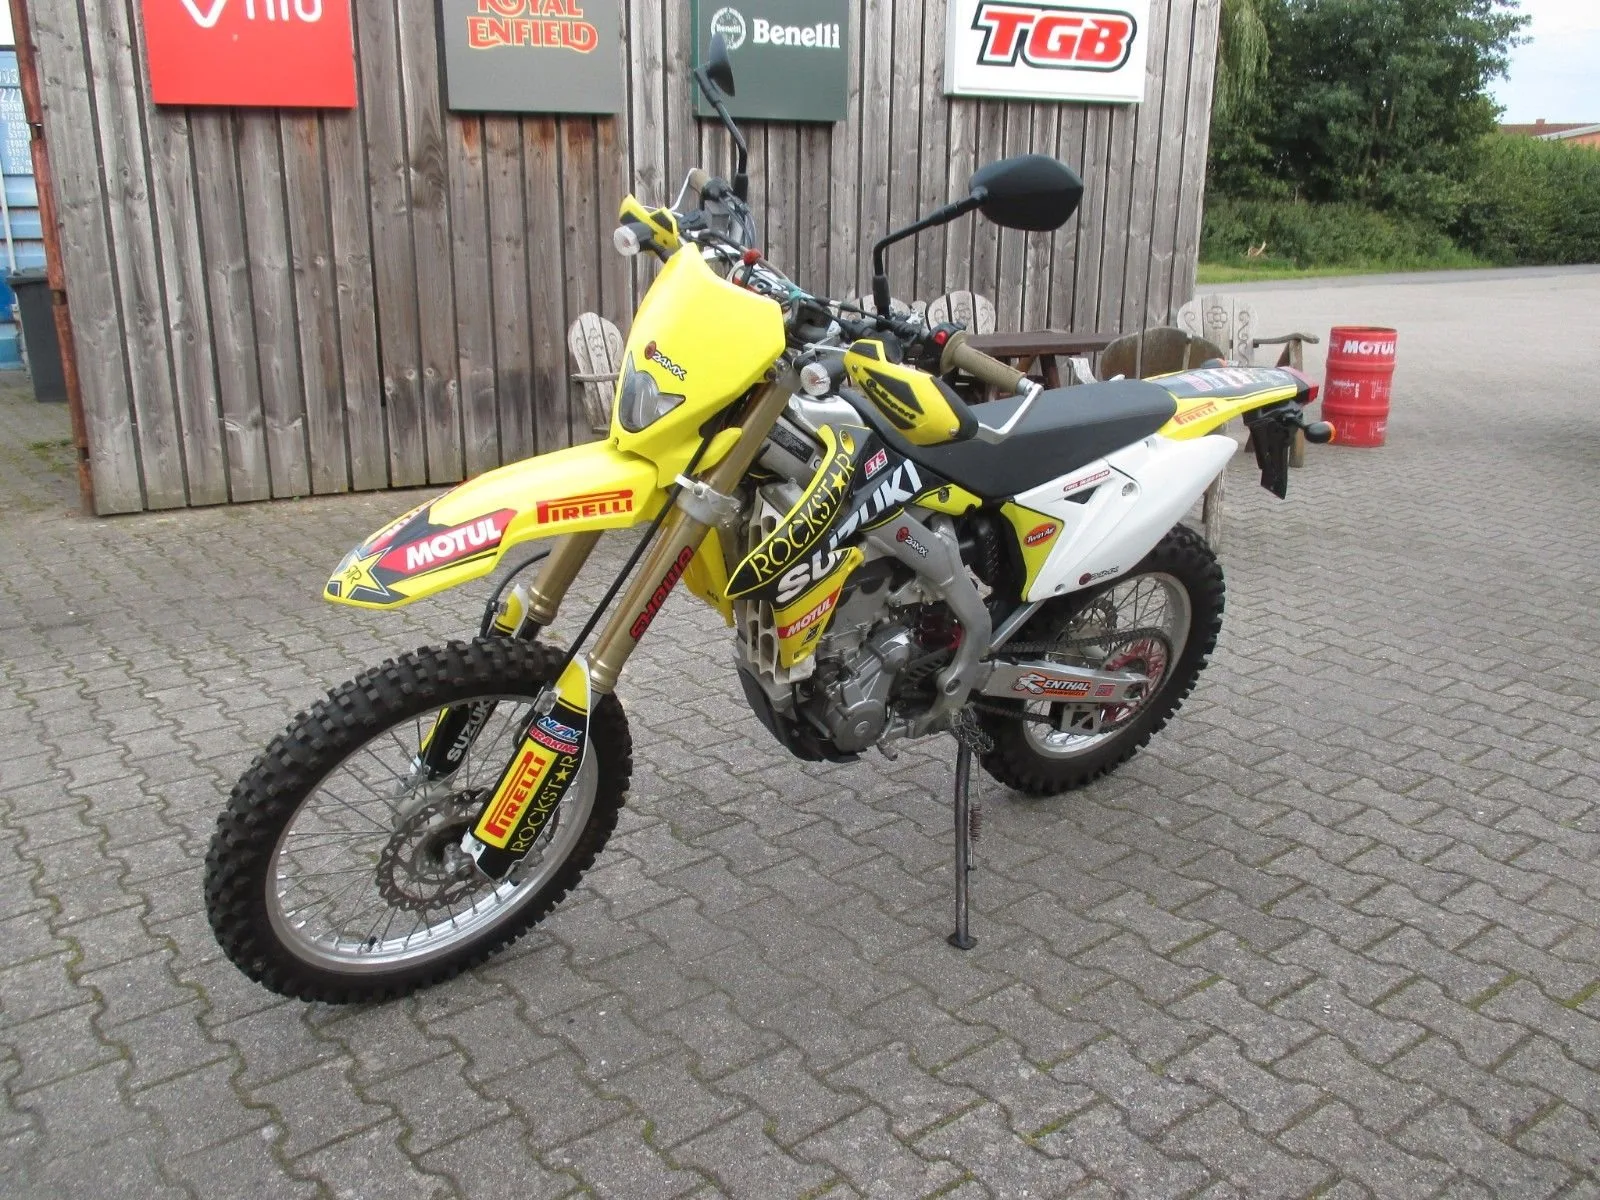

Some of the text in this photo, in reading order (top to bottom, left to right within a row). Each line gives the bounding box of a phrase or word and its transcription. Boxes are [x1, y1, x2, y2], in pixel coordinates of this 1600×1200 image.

[478, 0, 583, 18] ROYAL
[467, 16, 598, 53] ENFIELD
[753, 18, 840, 48] Benelli
[981, 7, 1131, 67] TGB
[1173, 401, 1218, 425] PIRELLI
[536, 489, 633, 524] PIRELLI
[407, 518, 502, 570] MOTUL
[1027, 531, 1044, 543] Twin
[786, 598, 831, 637] MOTUL
[1014, 672, 1091, 694] RENTHAL
[447, 700, 492, 762] SUZUK
[529, 726, 580, 755] BRAKING
[484, 750, 546, 839] PIRELLI
